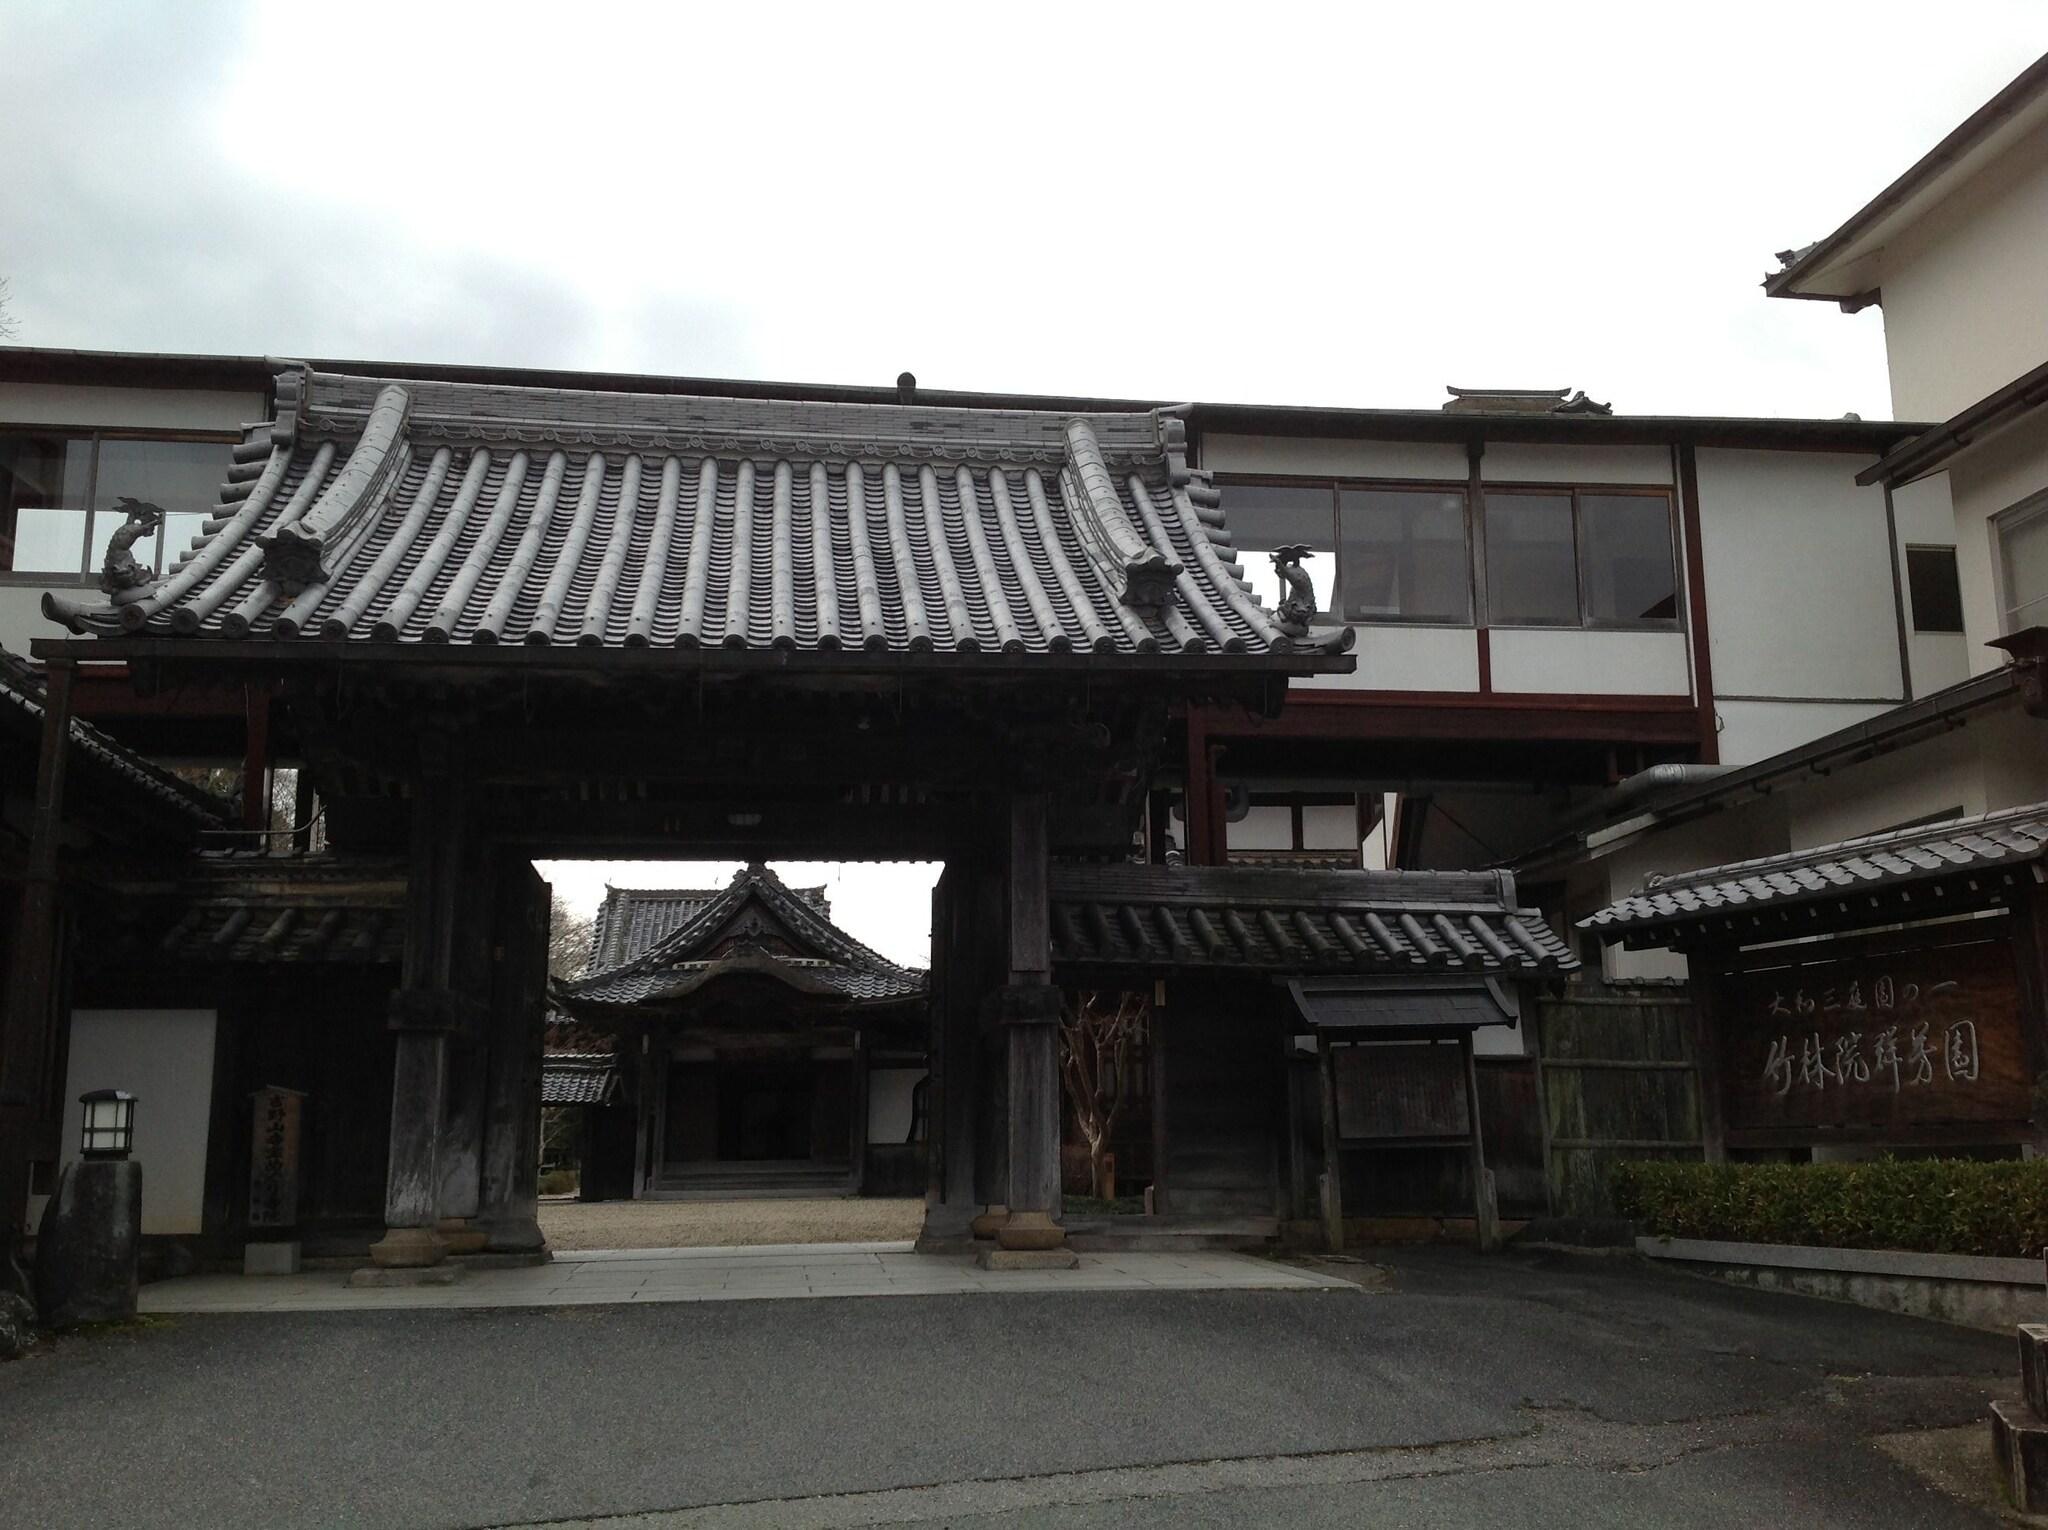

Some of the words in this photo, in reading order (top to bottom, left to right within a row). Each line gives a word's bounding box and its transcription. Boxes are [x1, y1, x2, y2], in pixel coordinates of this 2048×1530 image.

[1768, 975, 1958, 1015] 大和三庭園の一
[1763, 1019, 1979, 1095] 竹林院群芳園
